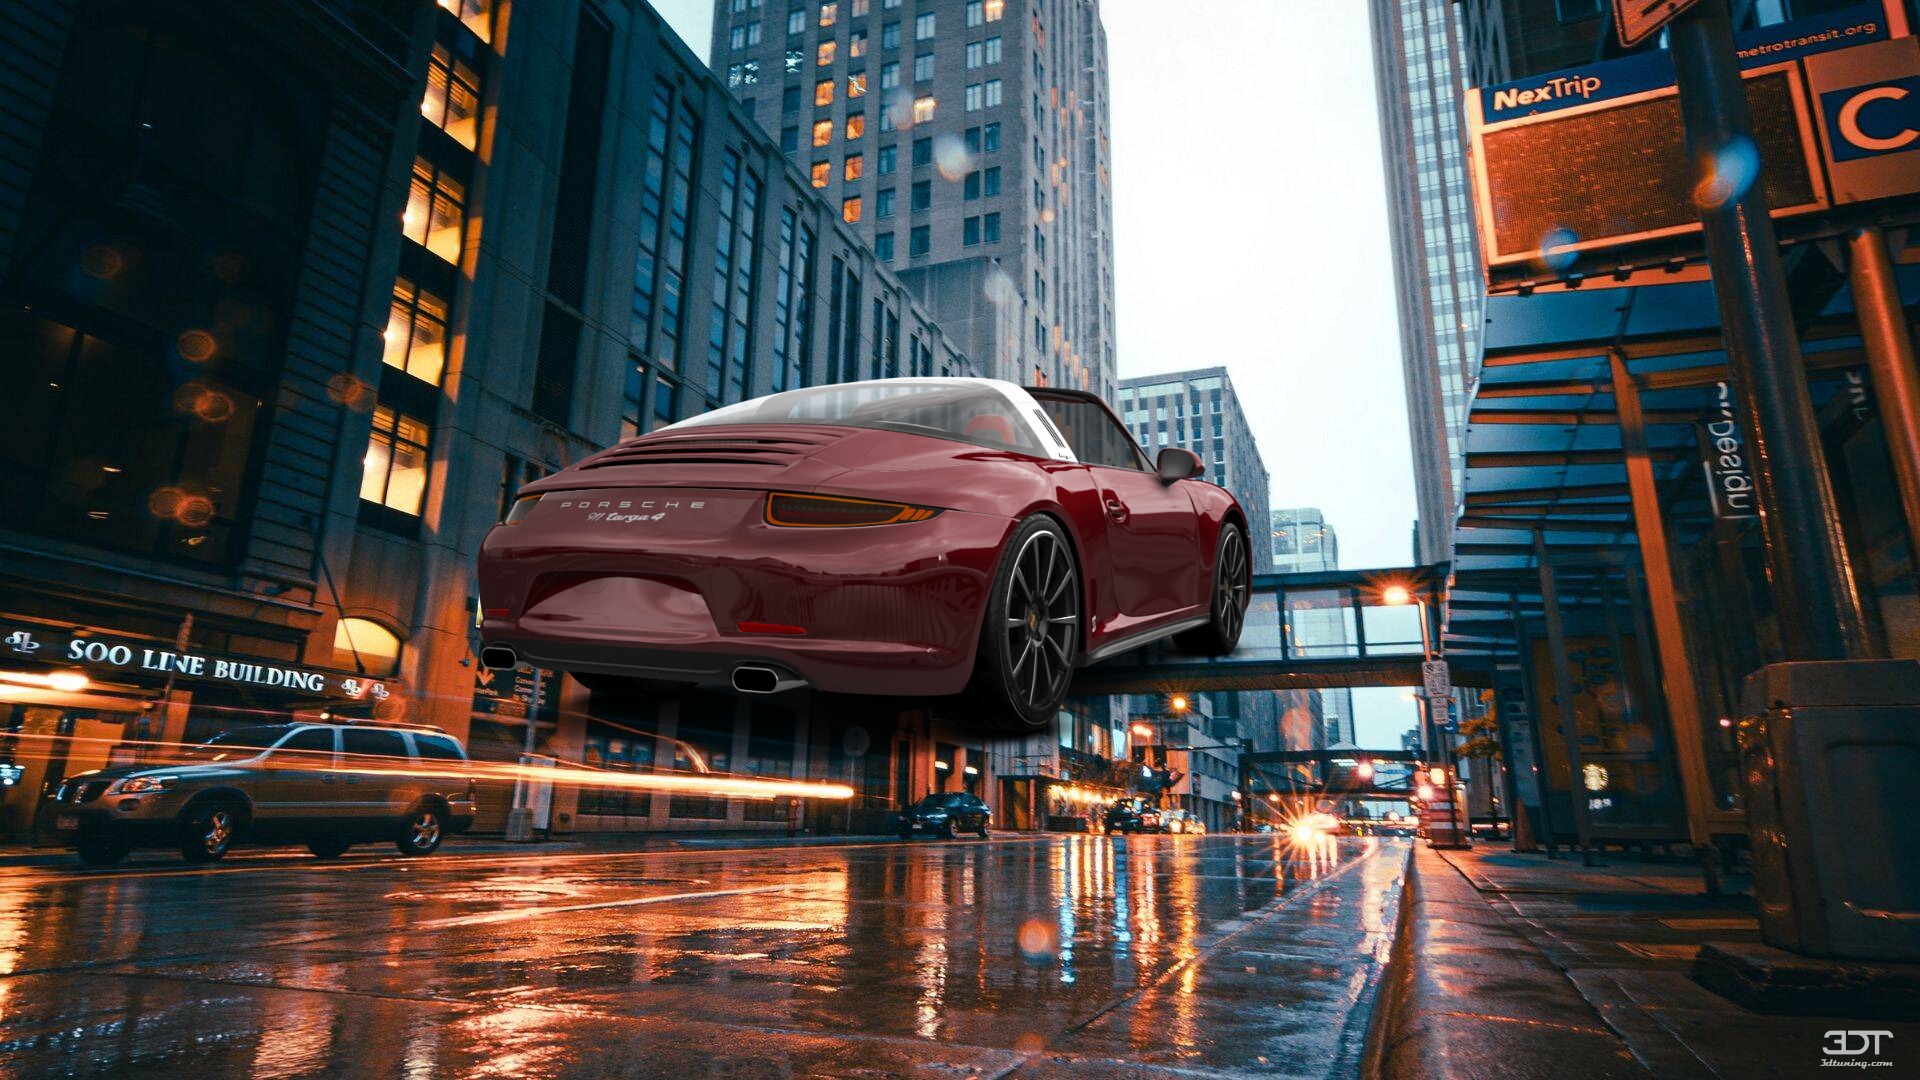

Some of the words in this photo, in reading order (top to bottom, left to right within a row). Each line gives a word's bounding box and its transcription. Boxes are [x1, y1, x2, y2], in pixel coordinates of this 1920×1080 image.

[1736, 22, 1877, 59] metrotransit.org
[1493, 75, 1602, 111] NexTrip
[1837, 86, 1920, 150] C
[560, 501, 706, 509] PORSCHE
[606, 512, 650, 523] targa
[650, 512, 666, 522] 4
[67, 639, 132, 666] SOO
[141, 649, 206, 677] LINE
[213, 659, 325, 692] BUILDING
